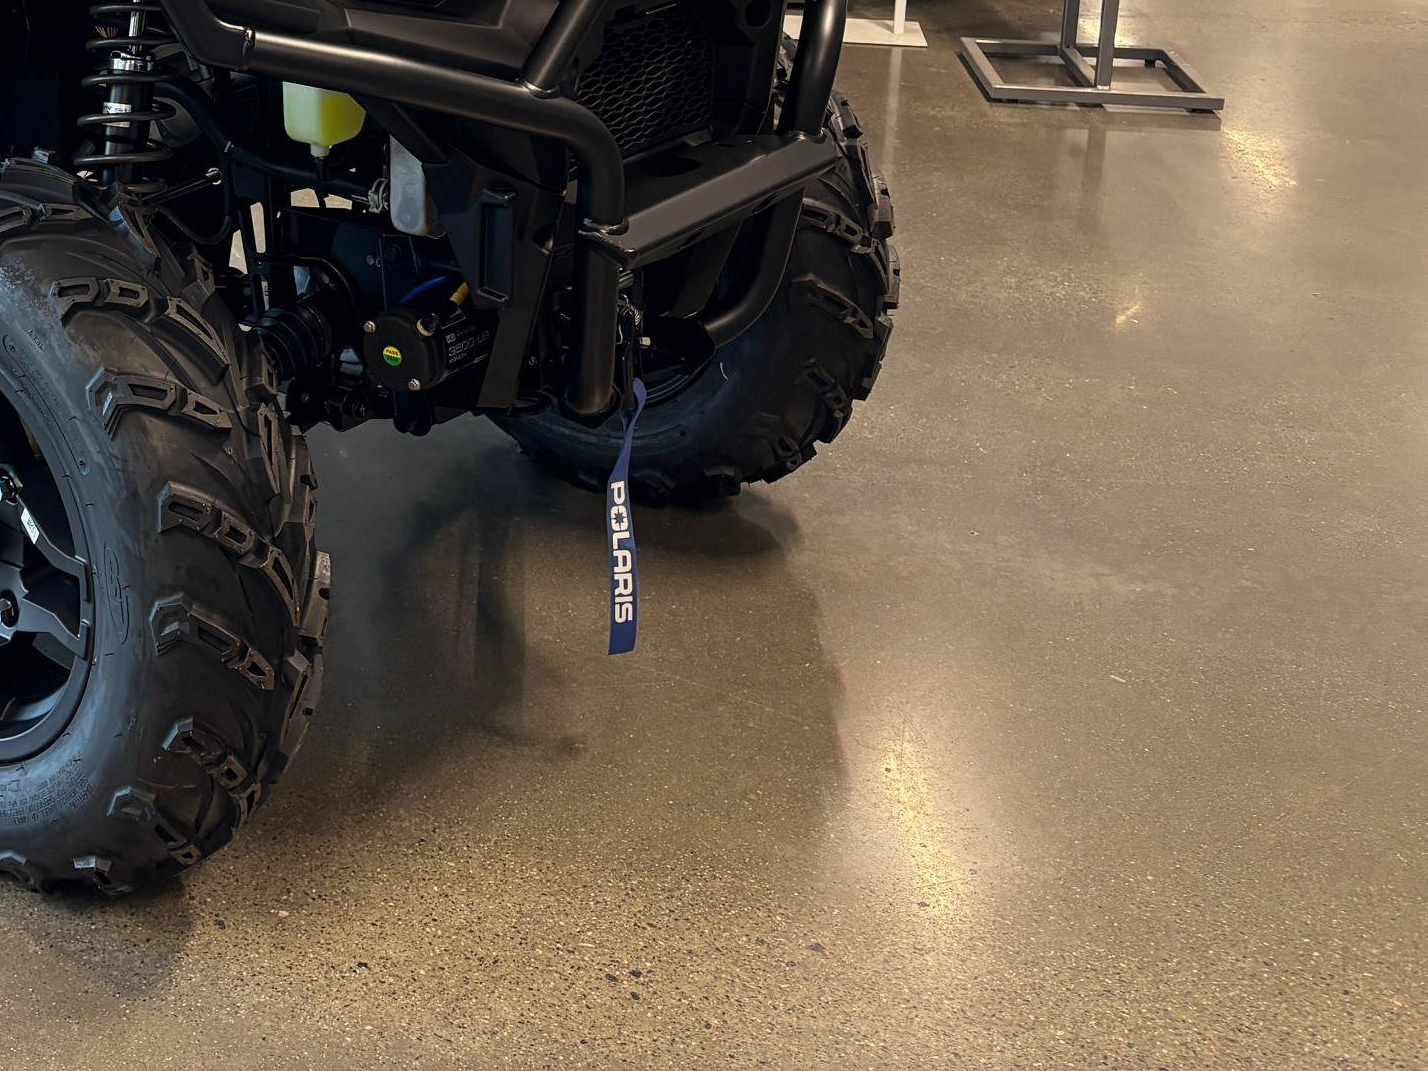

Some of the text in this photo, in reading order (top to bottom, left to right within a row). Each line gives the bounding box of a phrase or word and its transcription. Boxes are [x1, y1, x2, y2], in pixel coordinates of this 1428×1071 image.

[385, 349, 398, 357] PASS
[448, 337, 474, 357] 3500
[477, 330, 489, 343] LB
[610, 481, 633, 623] POLARIS
